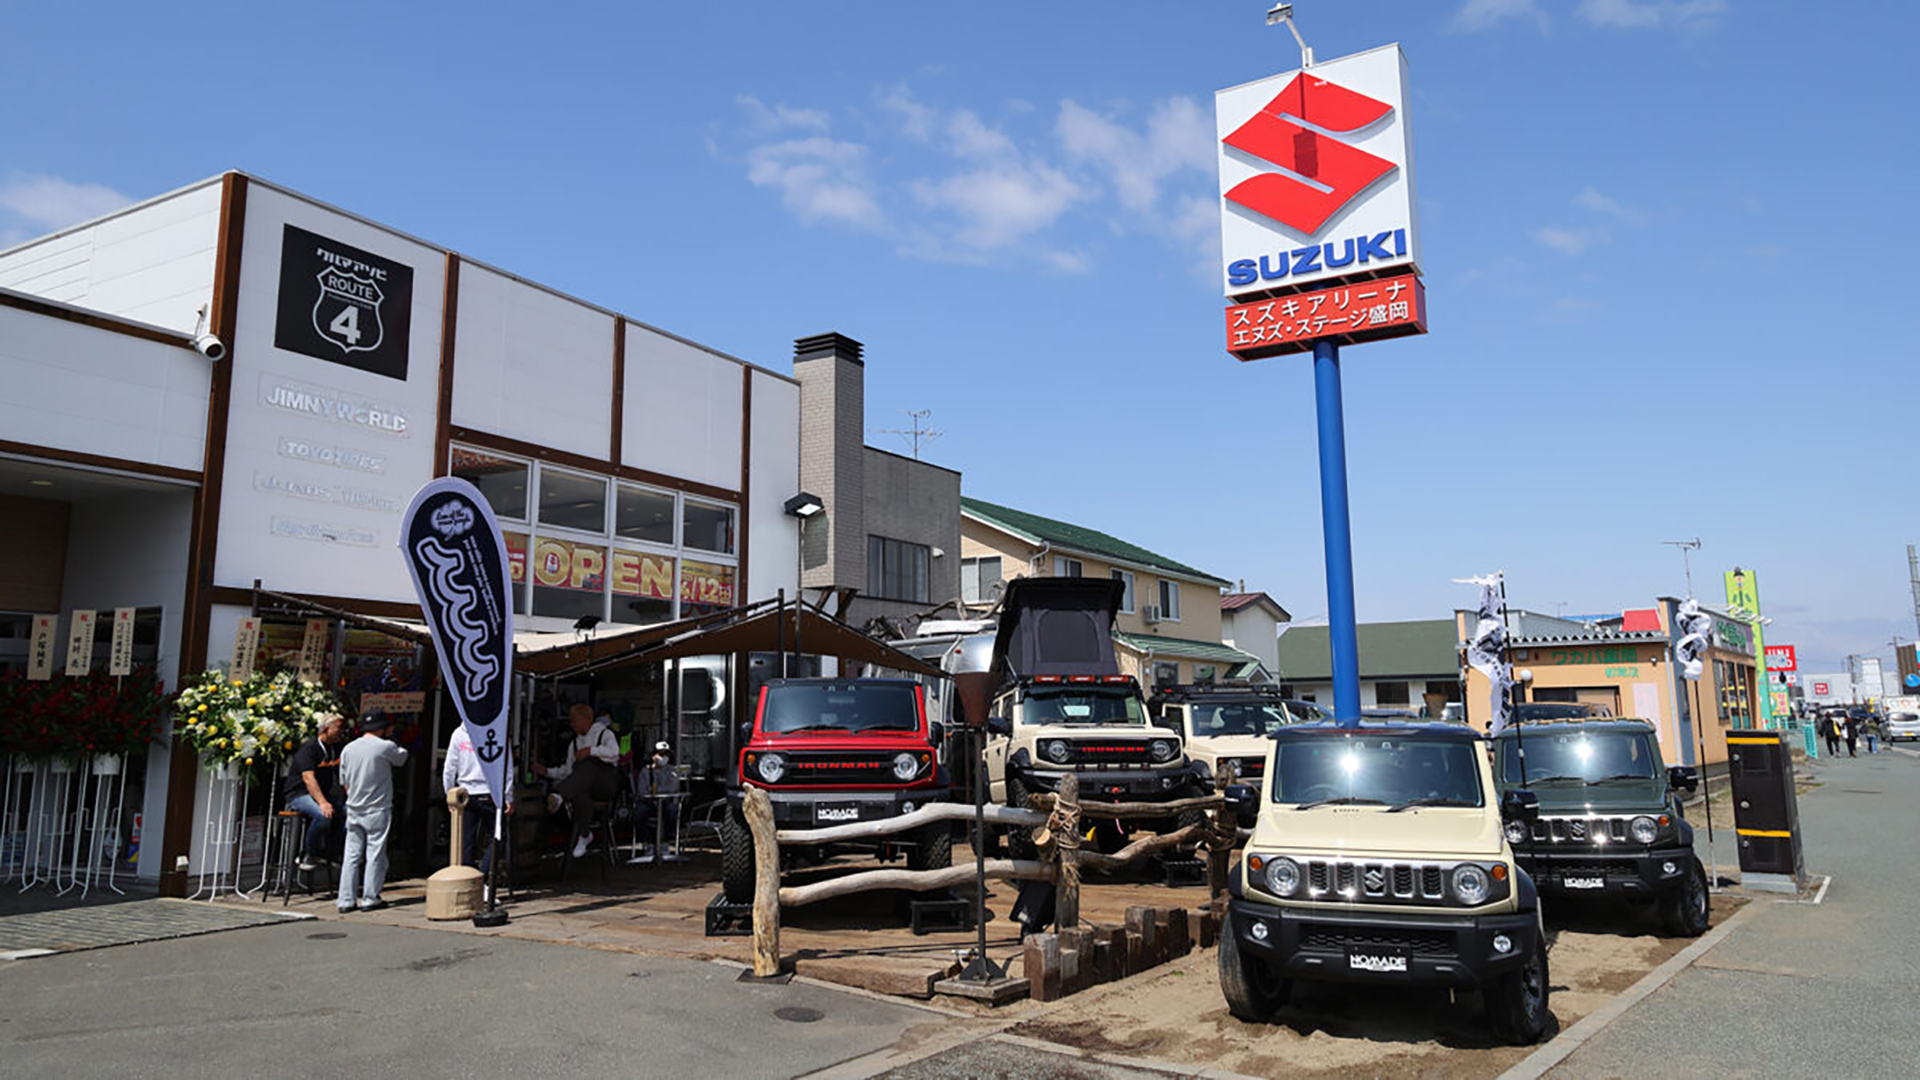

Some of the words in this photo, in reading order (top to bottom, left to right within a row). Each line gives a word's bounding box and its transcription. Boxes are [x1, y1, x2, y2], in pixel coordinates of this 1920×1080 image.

[1228, 228, 1407, 286] SUZUKI
[328, 274, 374, 300] ROUTE
[1233, 281, 1407, 328] スズキアリーナ
[330, 304, 362, 345] 4
[1233, 300, 1409, 346] エヌズ・ステージ盛岡
[266, 386, 333, 418] JIMNY
[336, 400, 407, 433] WORLD
[535, 541, 674, 598] OPEN
[818, 808, 859, 820] NOMADE
[1564, 878, 1604, 888] NOMADE
[1350, 955, 1407, 970] NOMADE
